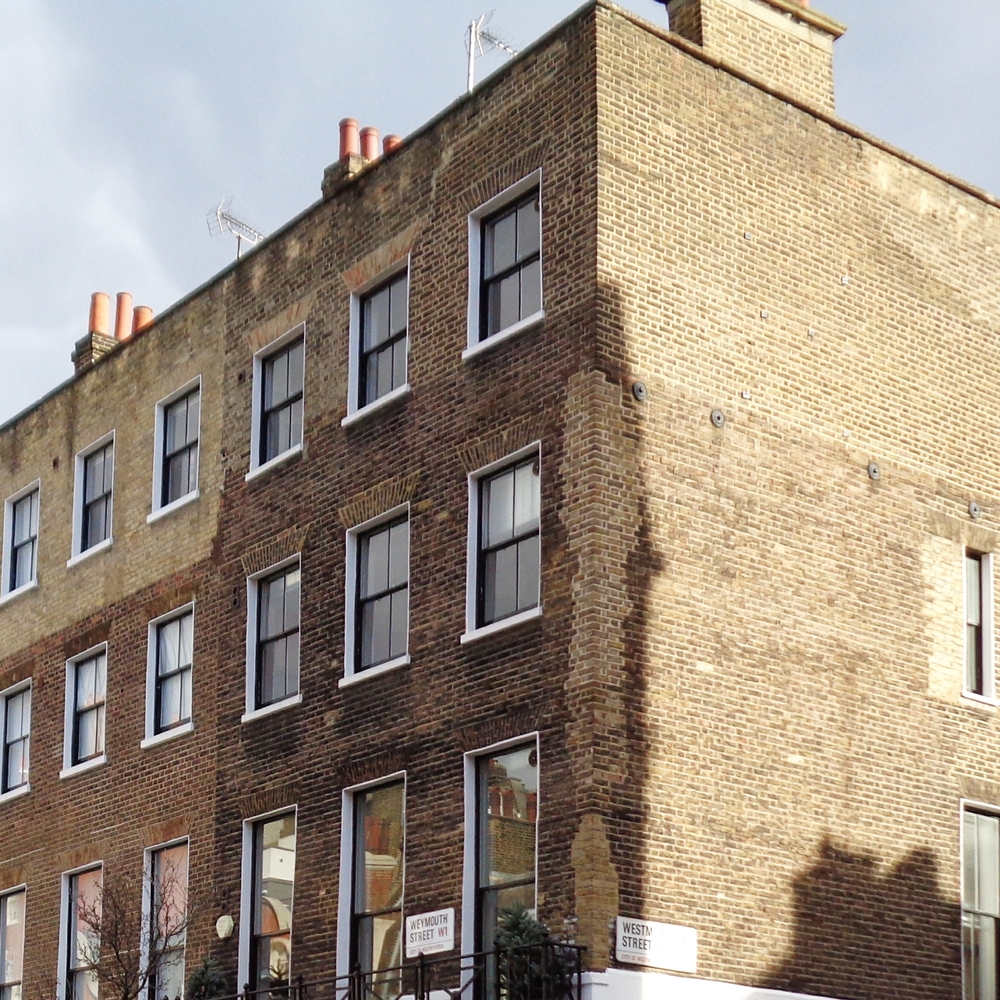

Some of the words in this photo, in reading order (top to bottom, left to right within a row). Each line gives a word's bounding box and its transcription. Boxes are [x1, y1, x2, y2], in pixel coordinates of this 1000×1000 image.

[410, 913, 448, 931] WEYMOUTH
[410, 928, 434, 943] STREET
[437, 926, 448, 937] W1
[621, 935, 652, 951] STREET
